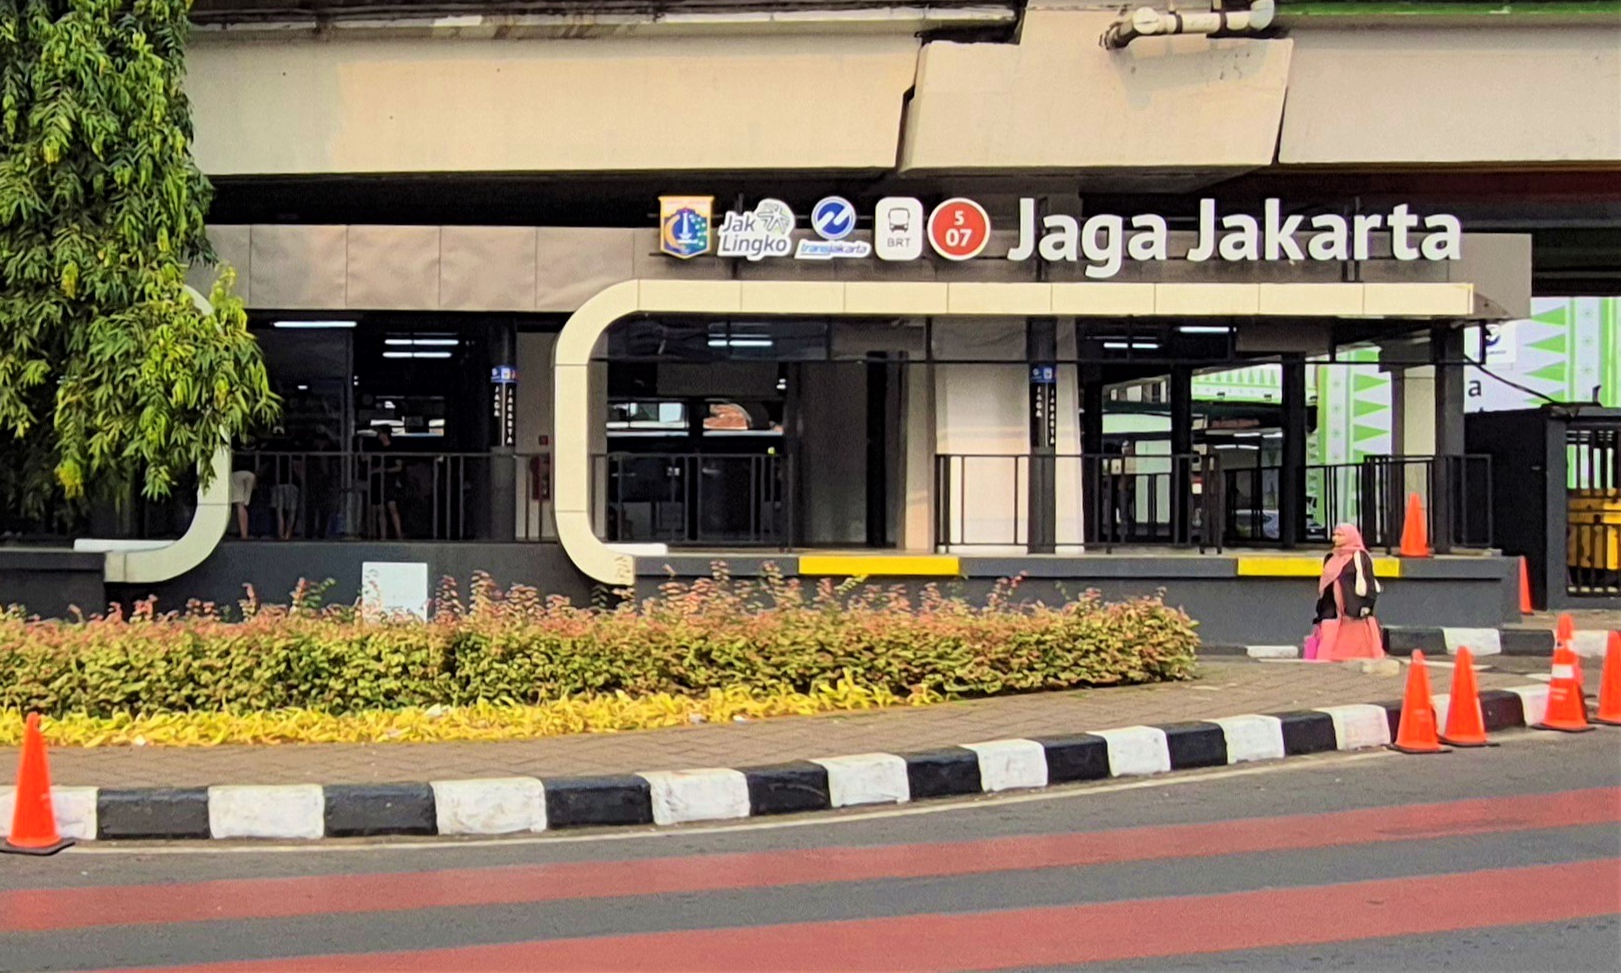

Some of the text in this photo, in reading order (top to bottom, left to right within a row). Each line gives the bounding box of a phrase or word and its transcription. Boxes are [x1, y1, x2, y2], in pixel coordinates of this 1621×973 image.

[722, 214, 756, 232] Jak
[954, 210, 964, 225] 5
[722, 234, 787, 256] Lingko
[887, 237, 911, 248] BRT
[945, 229, 972, 247] 07
[1006, 197, 1462, 279] Jaga Jakarta
